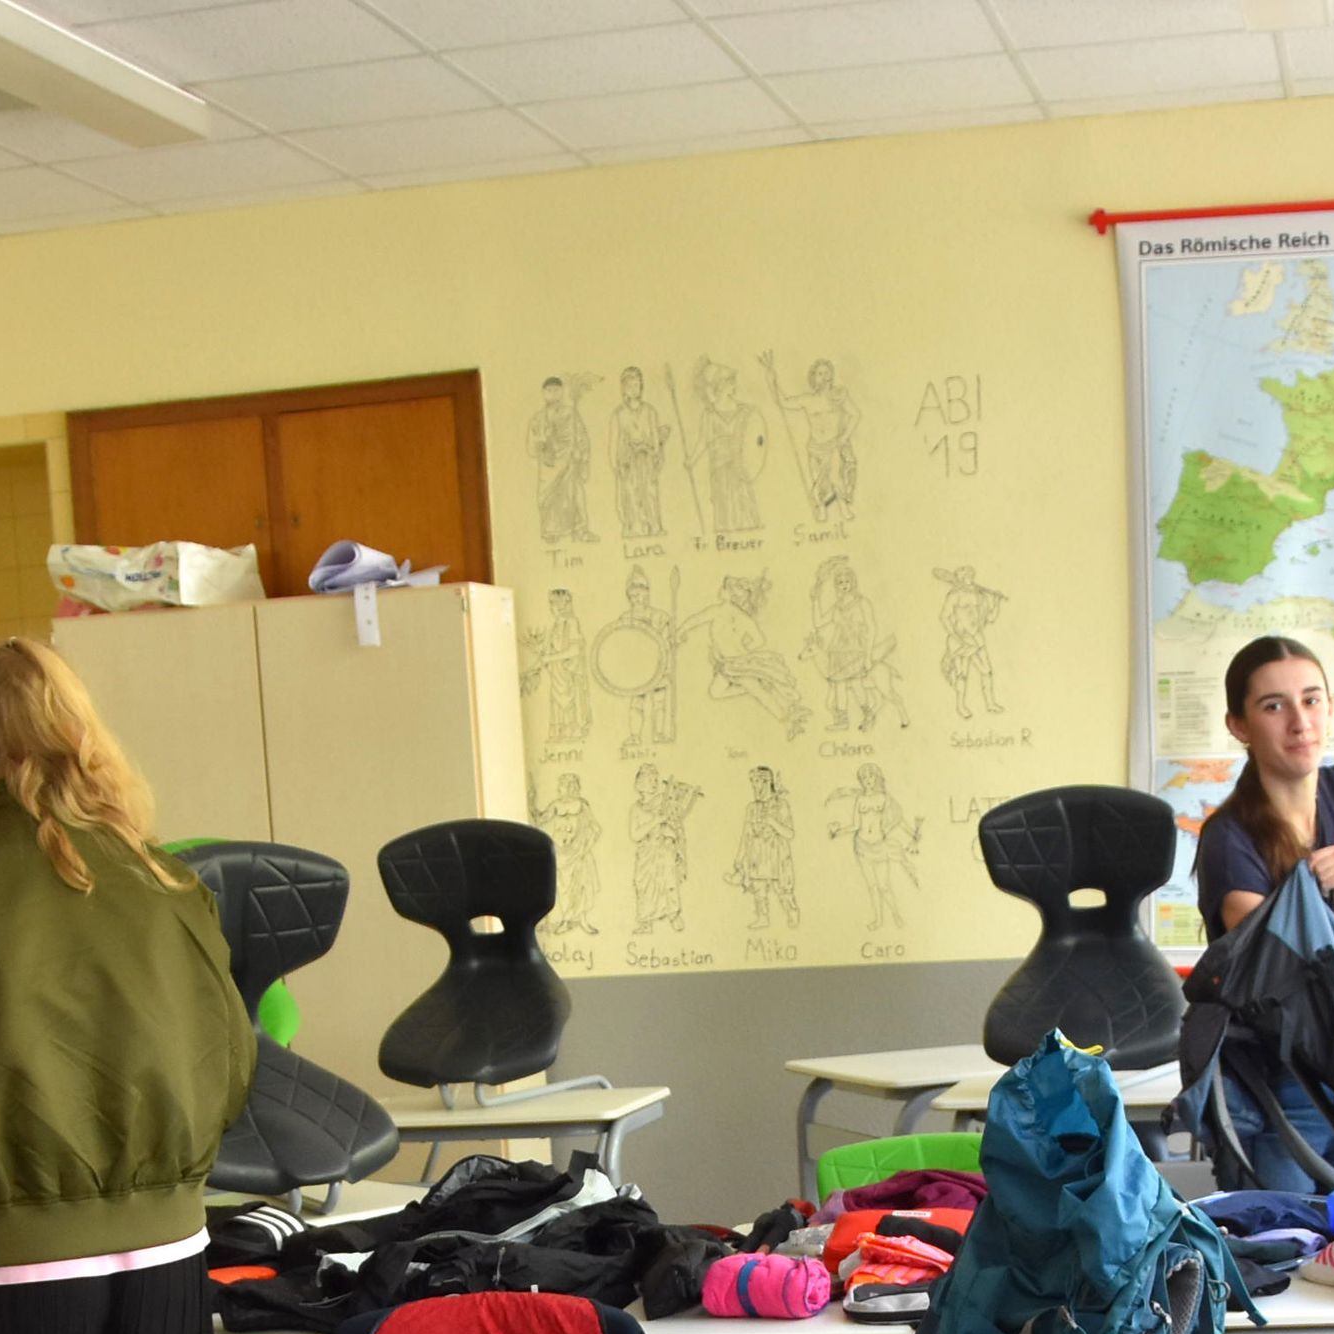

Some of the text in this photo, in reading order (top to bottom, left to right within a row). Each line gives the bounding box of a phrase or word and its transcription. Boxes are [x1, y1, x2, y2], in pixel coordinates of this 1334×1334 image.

[1138, 231, 1330, 255] Das Römische Reich
[914, 374, 983, 427] ABI
[626, 943, 714, 970] Sebastian
